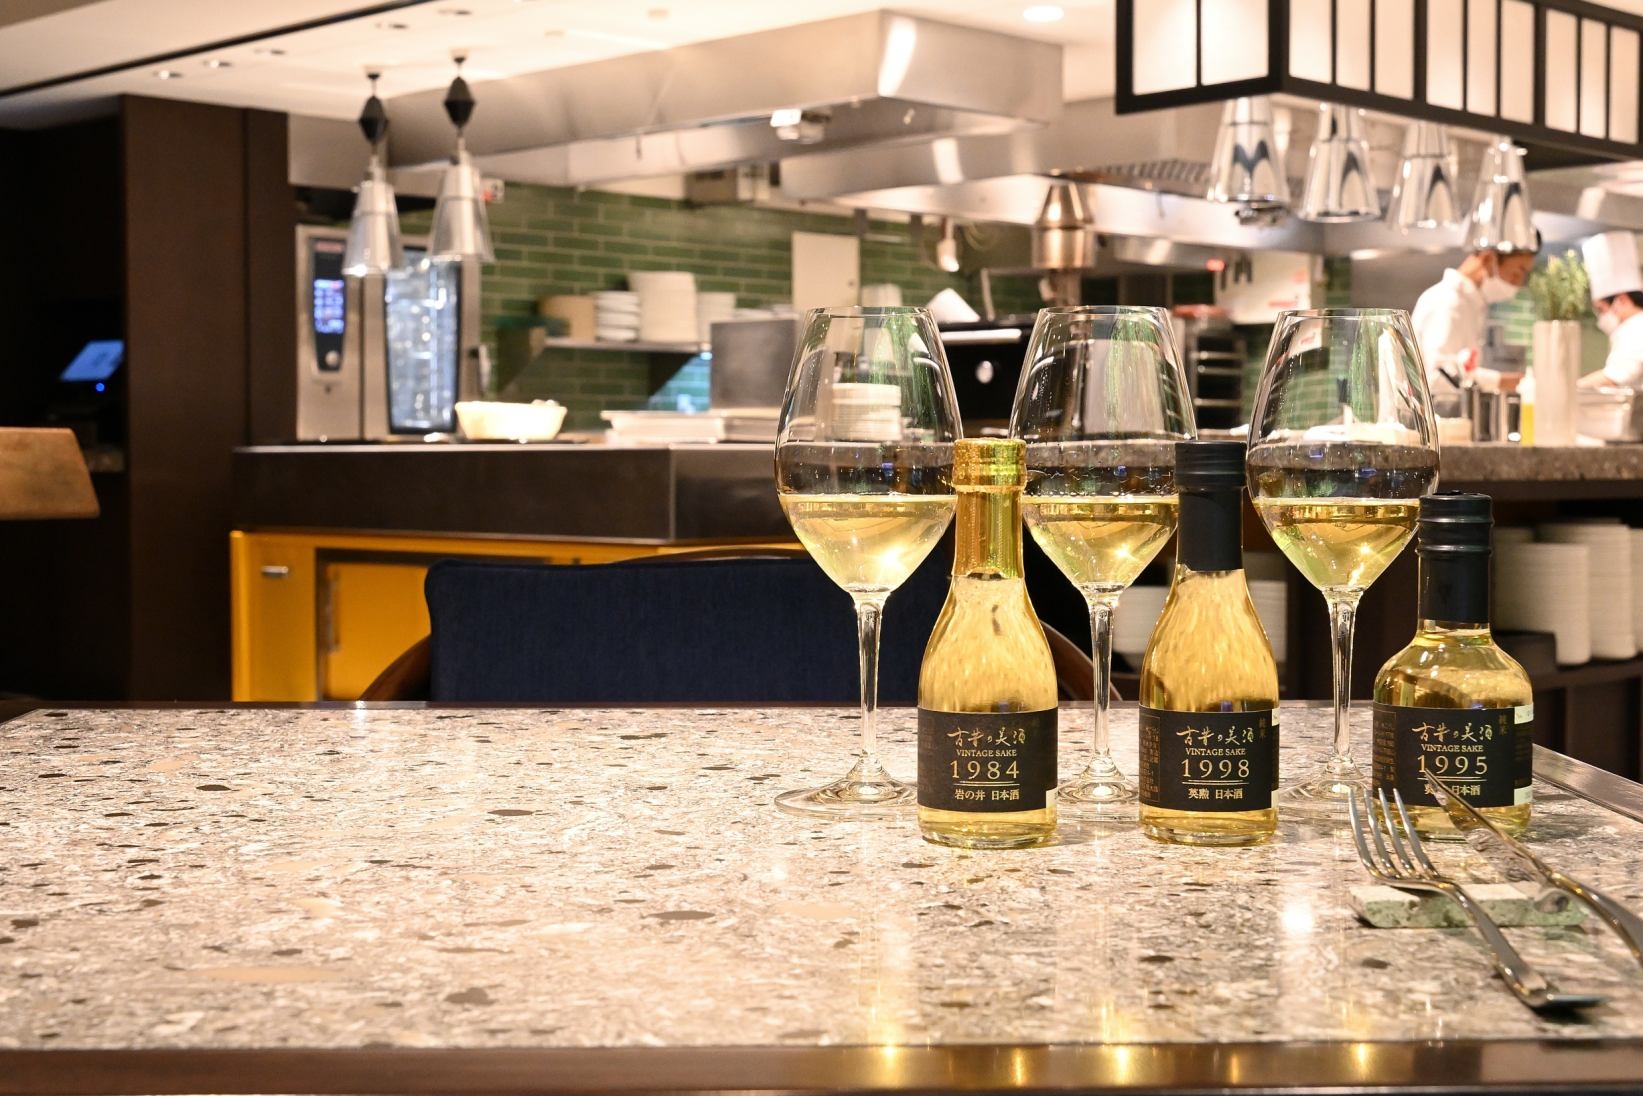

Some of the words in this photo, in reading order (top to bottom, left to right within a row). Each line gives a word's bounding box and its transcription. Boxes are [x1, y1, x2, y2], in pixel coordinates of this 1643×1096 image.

[956, 749, 994, 757] VINTAGE
[995, 749, 1018, 757] SAKE
[1185, 748, 1224, 756] VINTAGE
[1225, 748, 1246, 756] SAKE
[1421, 744, 1460, 753] VINTAGE
[1461, 744, 1484, 753] SAKE
[950, 760, 1020, 780] 1984
[1181, 759, 1250, 778] 1998
[1417, 755, 1488, 775] 1995
[954, 788, 986, 801] 岩の井
[991, 788, 1020, 801] 日本酒
[1215, 788, 1243, 800] 日本酒
[1451, 784, 1481, 796] 日本酒
